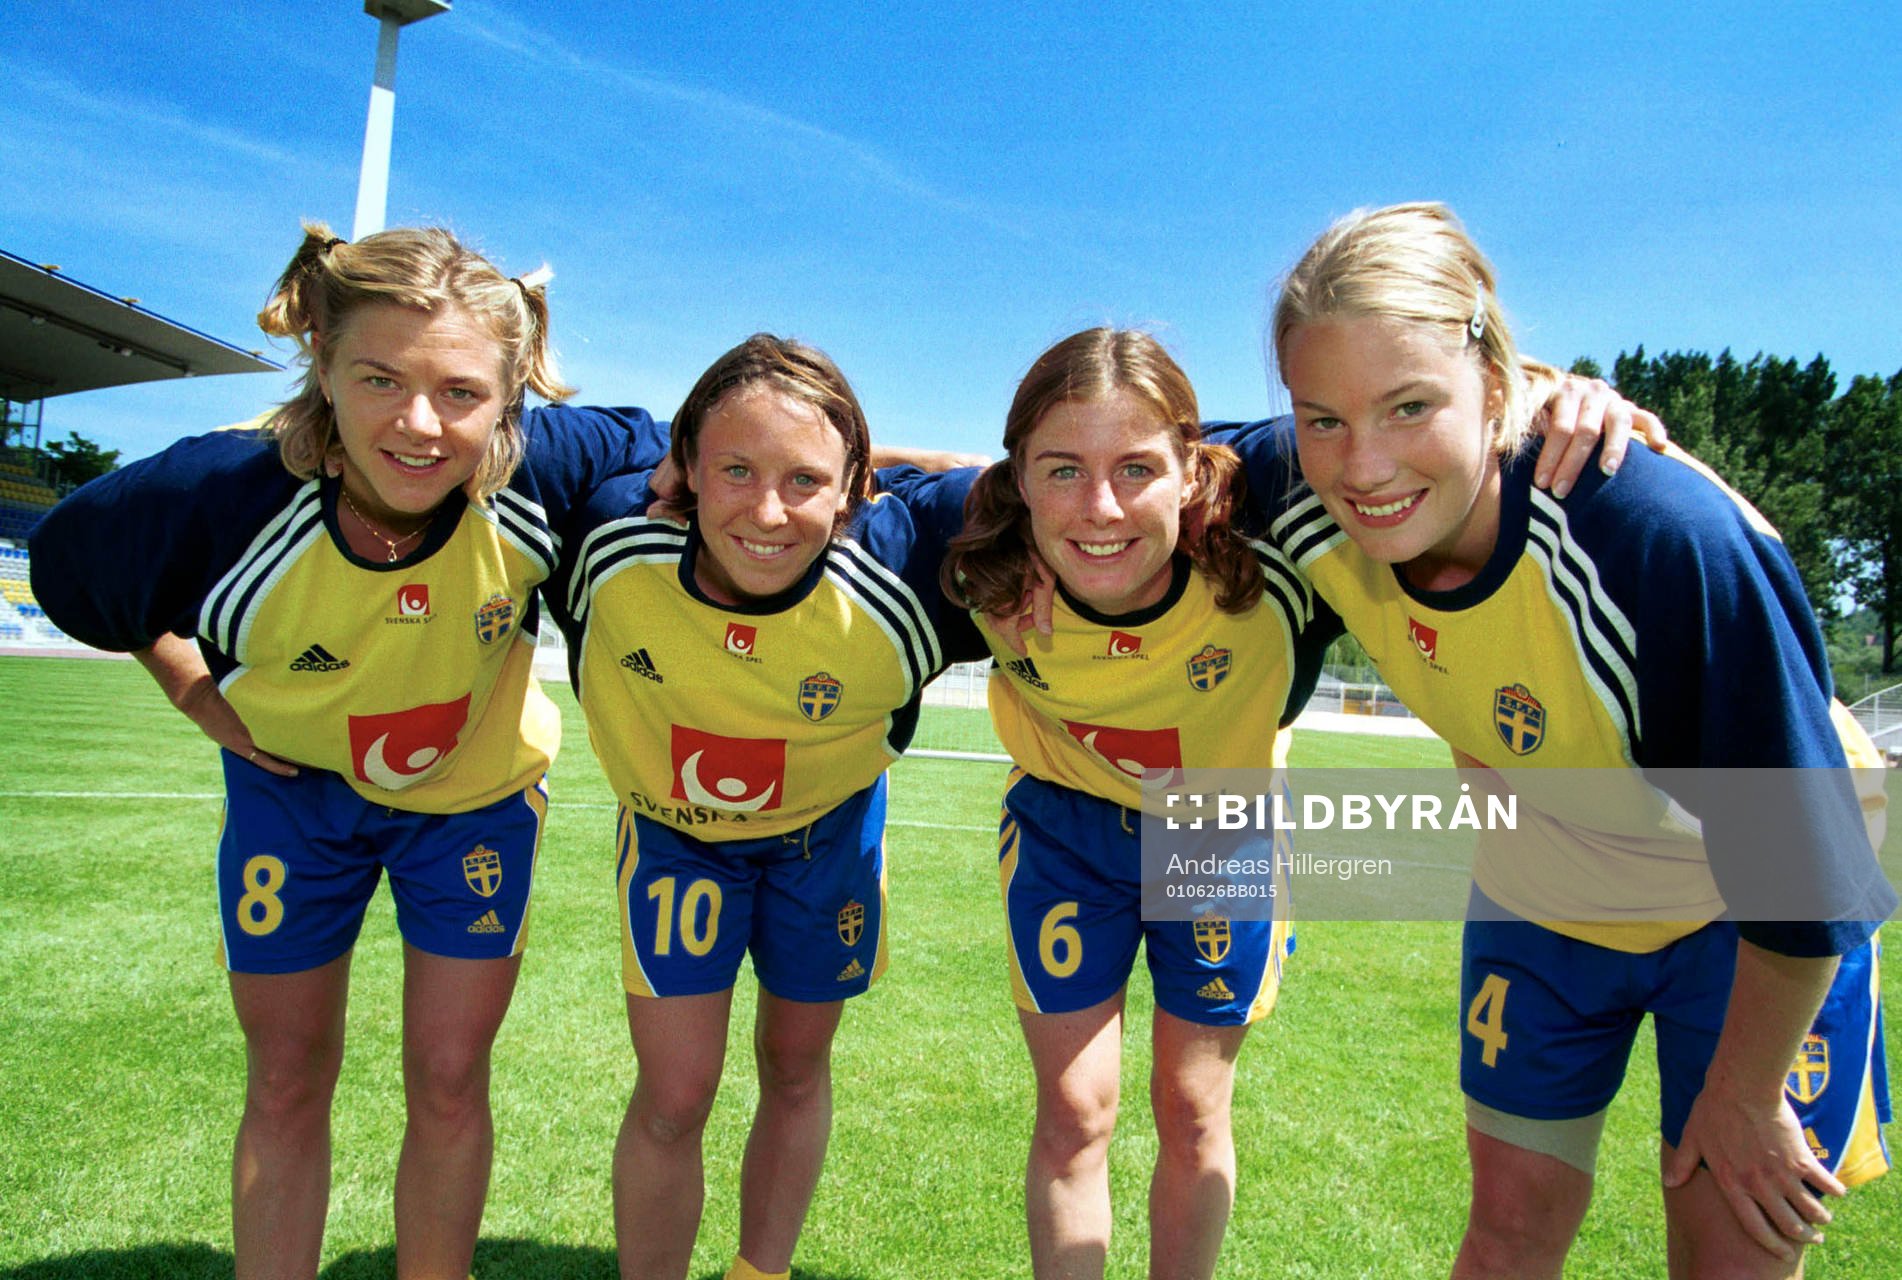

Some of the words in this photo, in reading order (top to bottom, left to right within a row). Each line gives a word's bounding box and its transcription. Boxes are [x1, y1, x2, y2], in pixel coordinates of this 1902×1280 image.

[290, 659, 350, 672] adidas
[620, 658, 664, 684] adidas
[1006, 661, 1049, 691] adidas
[630, 791, 748, 826] SVENSKA
[237, 855, 286, 936] 8
[467, 924, 506, 934] adidas
[647, 876, 722, 957] 10
[1038, 901, 1083, 978] 6
[1467, 973, 1510, 1068] 4
